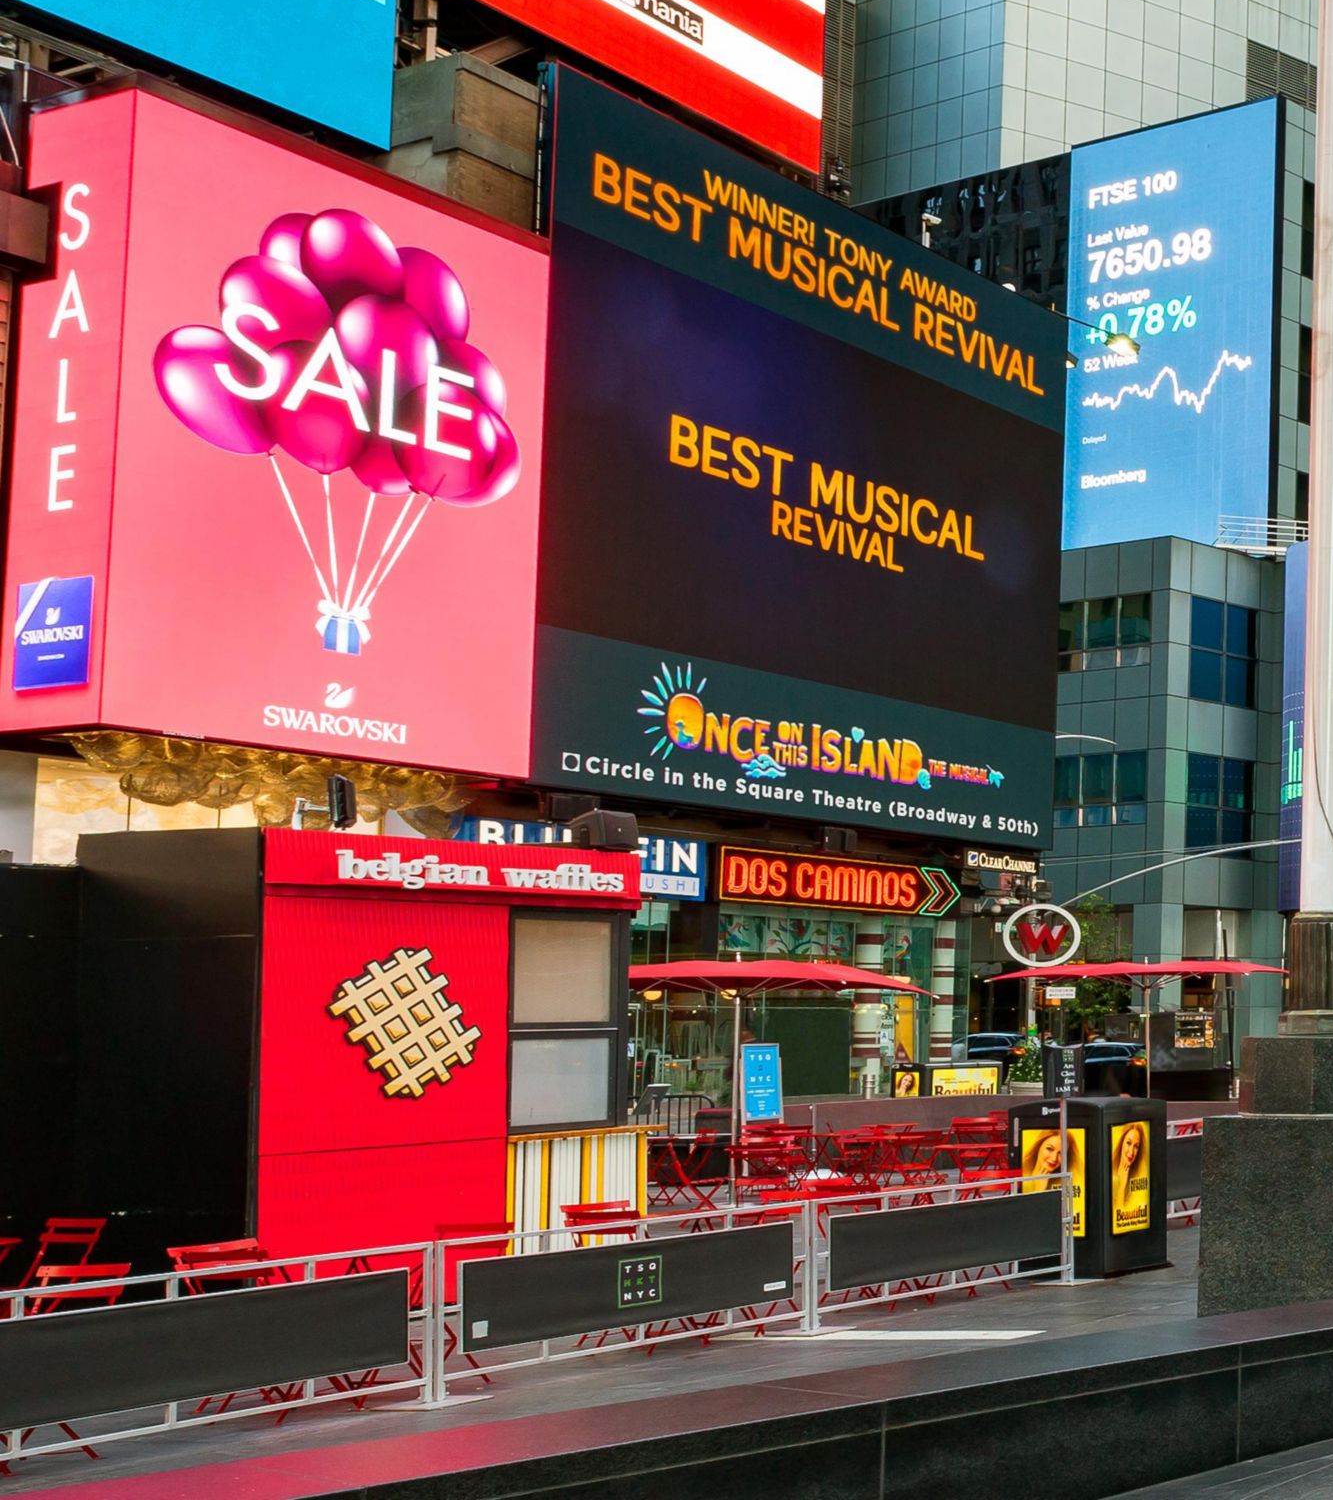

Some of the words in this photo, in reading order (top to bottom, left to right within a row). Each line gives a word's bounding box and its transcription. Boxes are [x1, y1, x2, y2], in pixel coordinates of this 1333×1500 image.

[1088, 178, 1138, 210] FTSE
[1141, 170, 1177, 197] 100
[703, 169, 815, 248] WINNER!
[825, 230, 892, 281] TONY
[900, 268, 977, 322] AWARD
[1087, 230, 1113, 248] Last
[1115, 222, 1149, 241] Value
[1088, 228, 1213, 284] 7650.98
[592, 153, 712, 243] BEST
[729, 216, 900, 331] MUSICAL
[913, 308, 1043, 396] REVIVAL
[1103, 287, 1151, 309] Change
[1086, 295, 1198, 346] +078%
[48, 183, 90, 513] SALE
[1084, 356, 1101, 374] 52
[213, 301, 476, 460] SALE
[669, 413, 793, 496] BEST
[810, 462, 984, 563] MUSICAL
[1081, 467, 1147, 490] Bloomberg
[771, 500, 904, 573] REVIVAL
[21, 625, 84, 646] SWAROVSKI
[263, 703, 407, 745] SWAROVSKI
[667, 693, 769, 763] ONCE
[777, 720, 804, 744] ON
[772, 742, 808, 767] THIS
[811, 724, 924, 785] ISLAND
[928, 758, 946, 776] THE
[585, 755, 655, 782] Circle
[664, 767, 685, 786] in
[693, 771, 727, 792] the
[736, 778, 804, 804] Square
[812, 789, 881, 815] Theatre
[888, 800, 976, 830] (Broadway
[981, 815, 993, 830] &
[998, 815, 1039, 838] 50th)
[336, 849, 489, 889] belgian
[501, 863, 624, 893] waffles
[646, 877, 697, 893] USHI
[727, 855, 787, 898] DOS
[795, 862, 917, 908] CAMINOS
[1016, 921, 1071, 956] W
[1116, 1204, 1148, 1222] Beautiful
[624, 1288, 656, 1301] NYC
